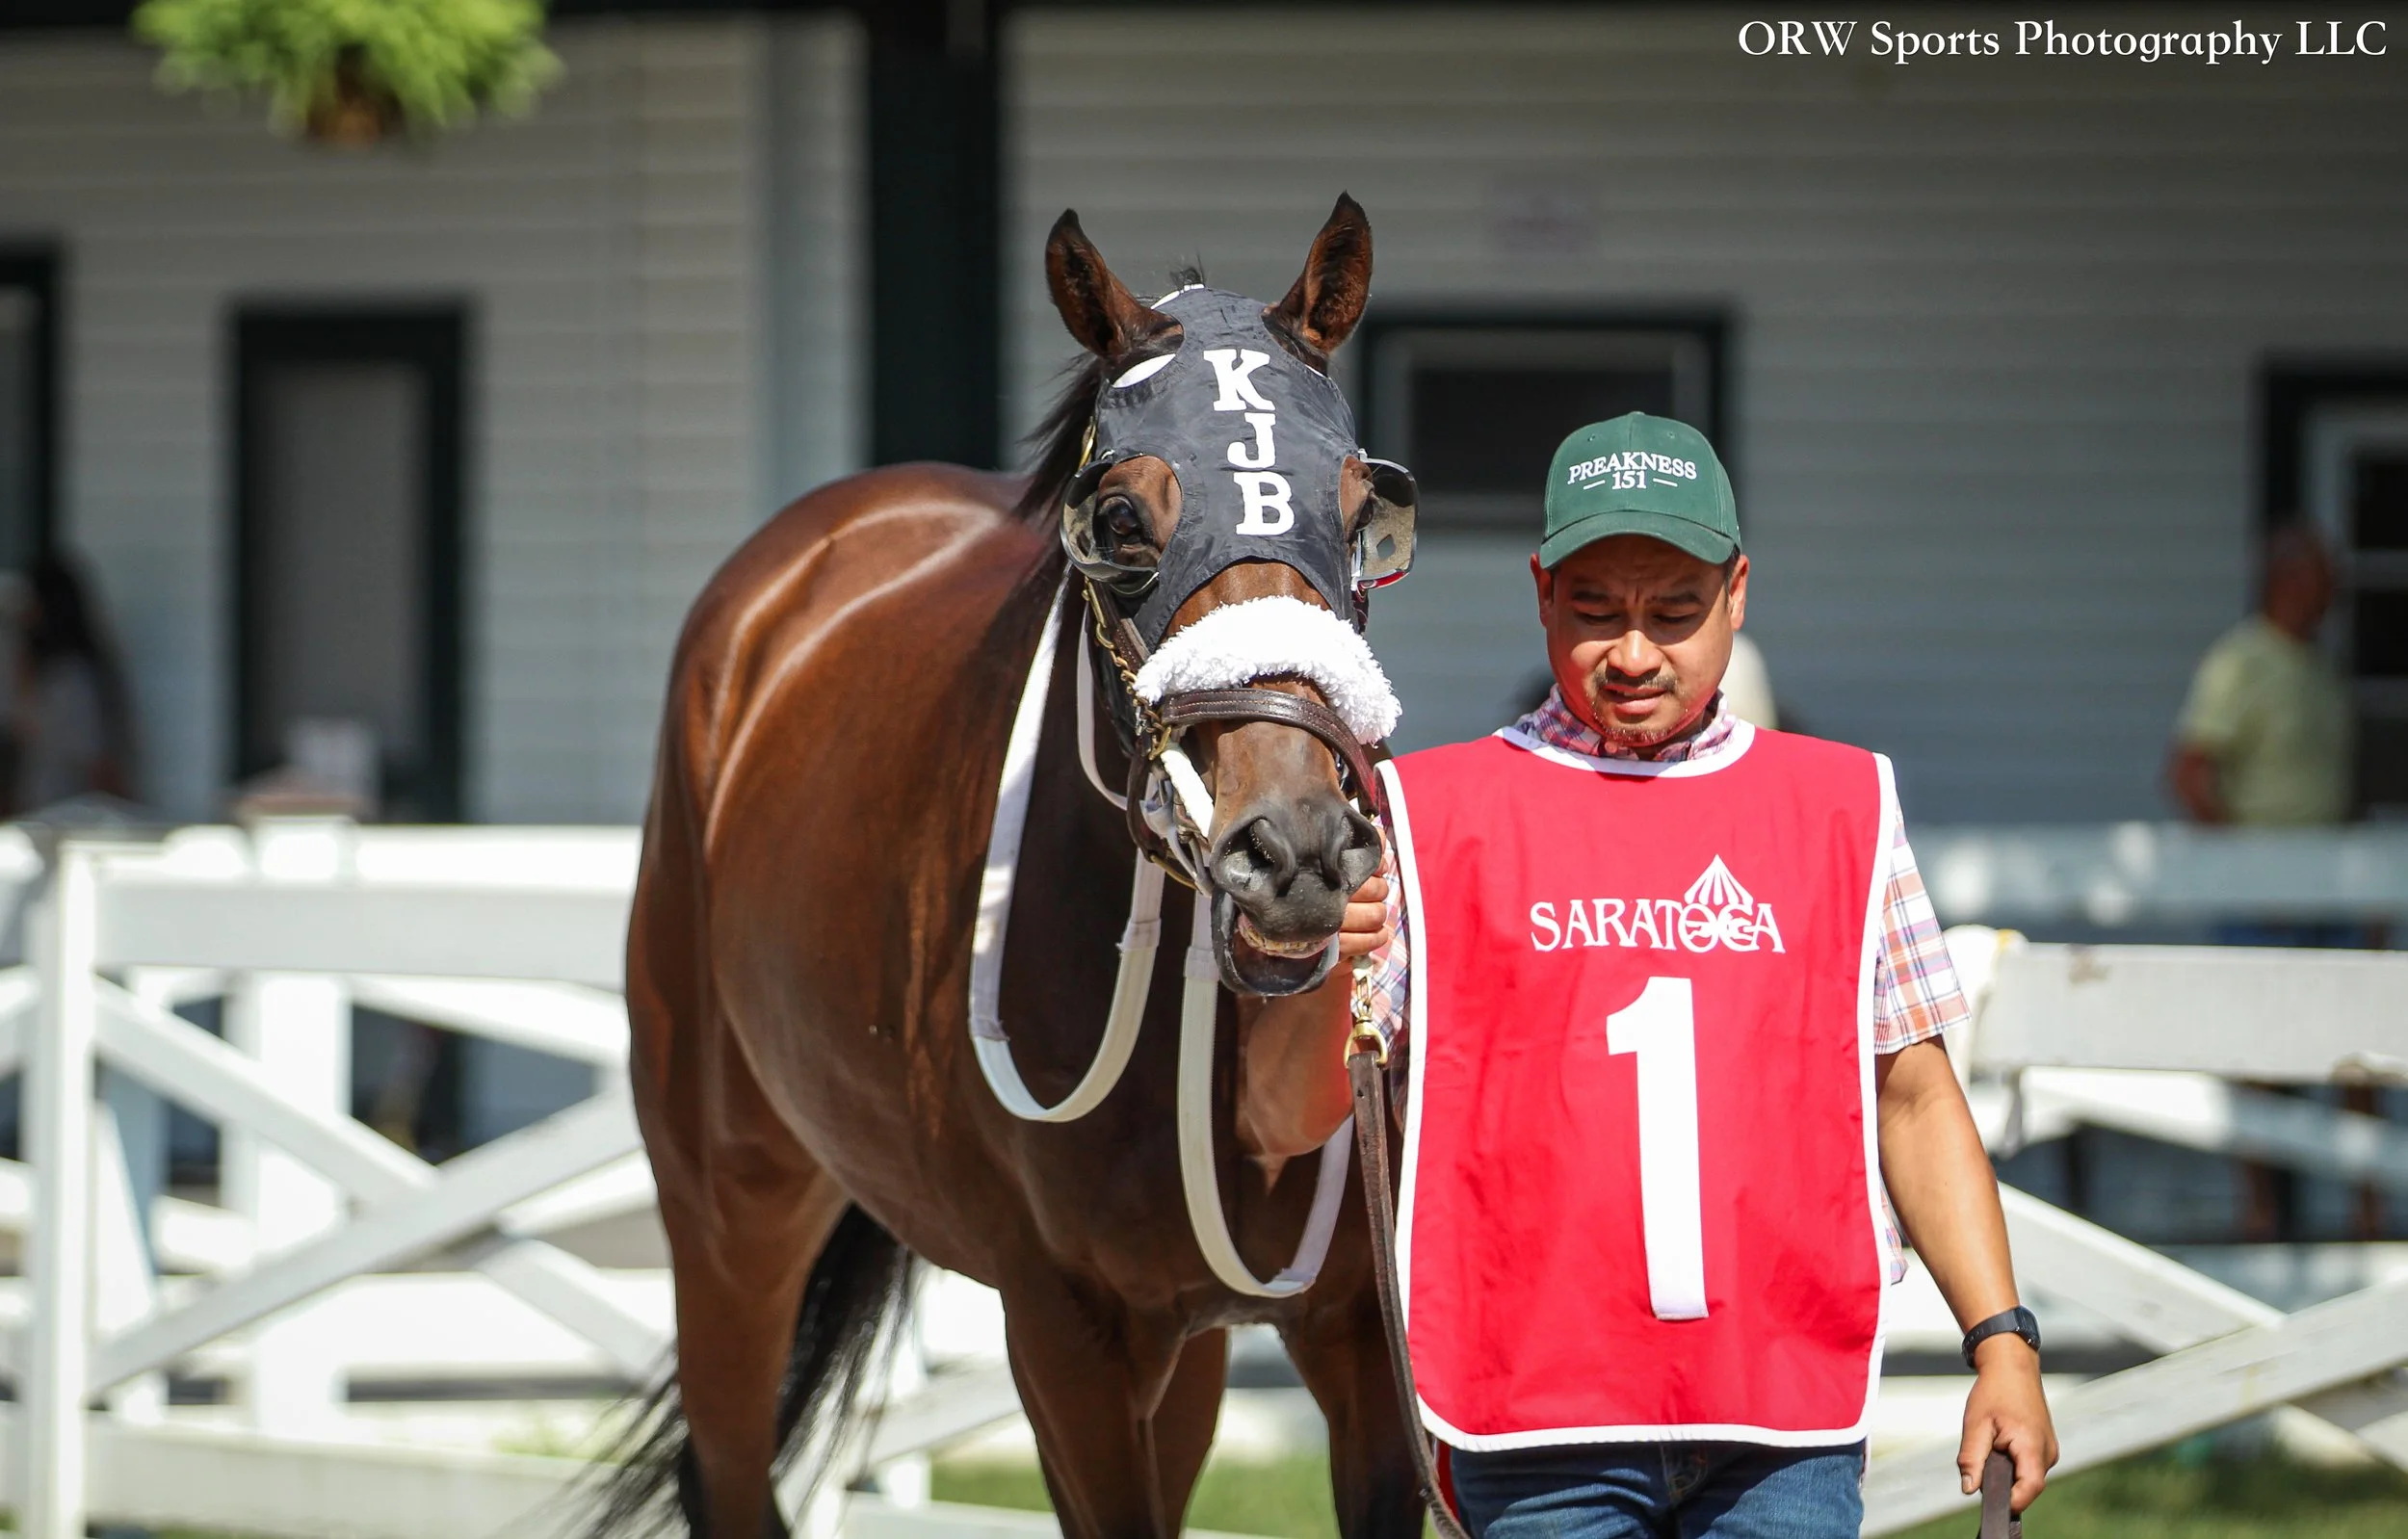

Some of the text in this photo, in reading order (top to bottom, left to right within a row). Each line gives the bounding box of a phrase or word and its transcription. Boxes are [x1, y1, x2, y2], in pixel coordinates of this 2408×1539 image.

[1567, 451, 1697, 484] PREAKNESS
[1611, 470, 1647, 490] 151
[1530, 898, 1786, 953] SARATOGA
[1606, 976, 1709, 1320] 1
